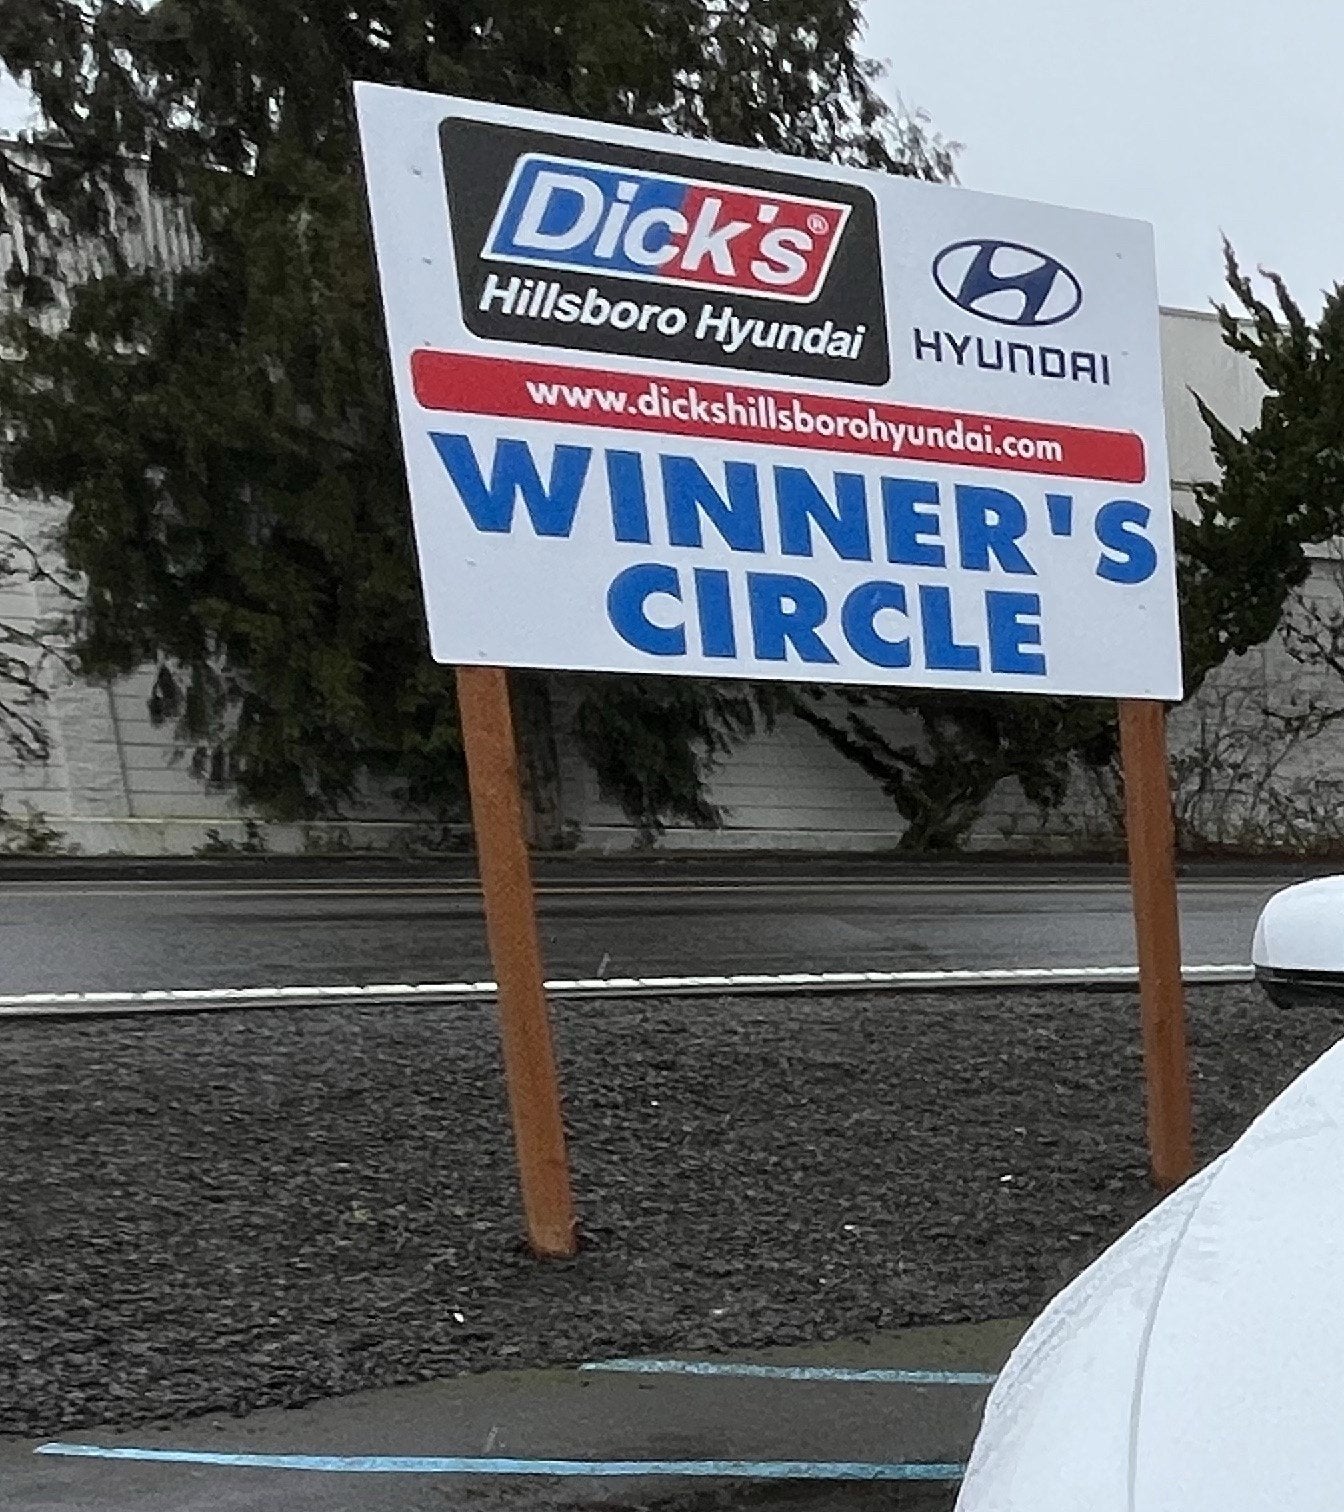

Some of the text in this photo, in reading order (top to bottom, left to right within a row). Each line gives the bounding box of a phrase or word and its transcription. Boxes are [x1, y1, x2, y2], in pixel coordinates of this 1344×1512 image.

[511, 170, 814, 286] Dick's
[478, 274, 867, 359] Hillsboro Hyundai
[914, 328, 1110, 386] HYUNDAI
[525, 375, 1064, 463] www.dickshillsborohyundai.com
[428, 432, 1158, 585] WINNER'S
[606, 562, 1047, 677] CIRCLE
